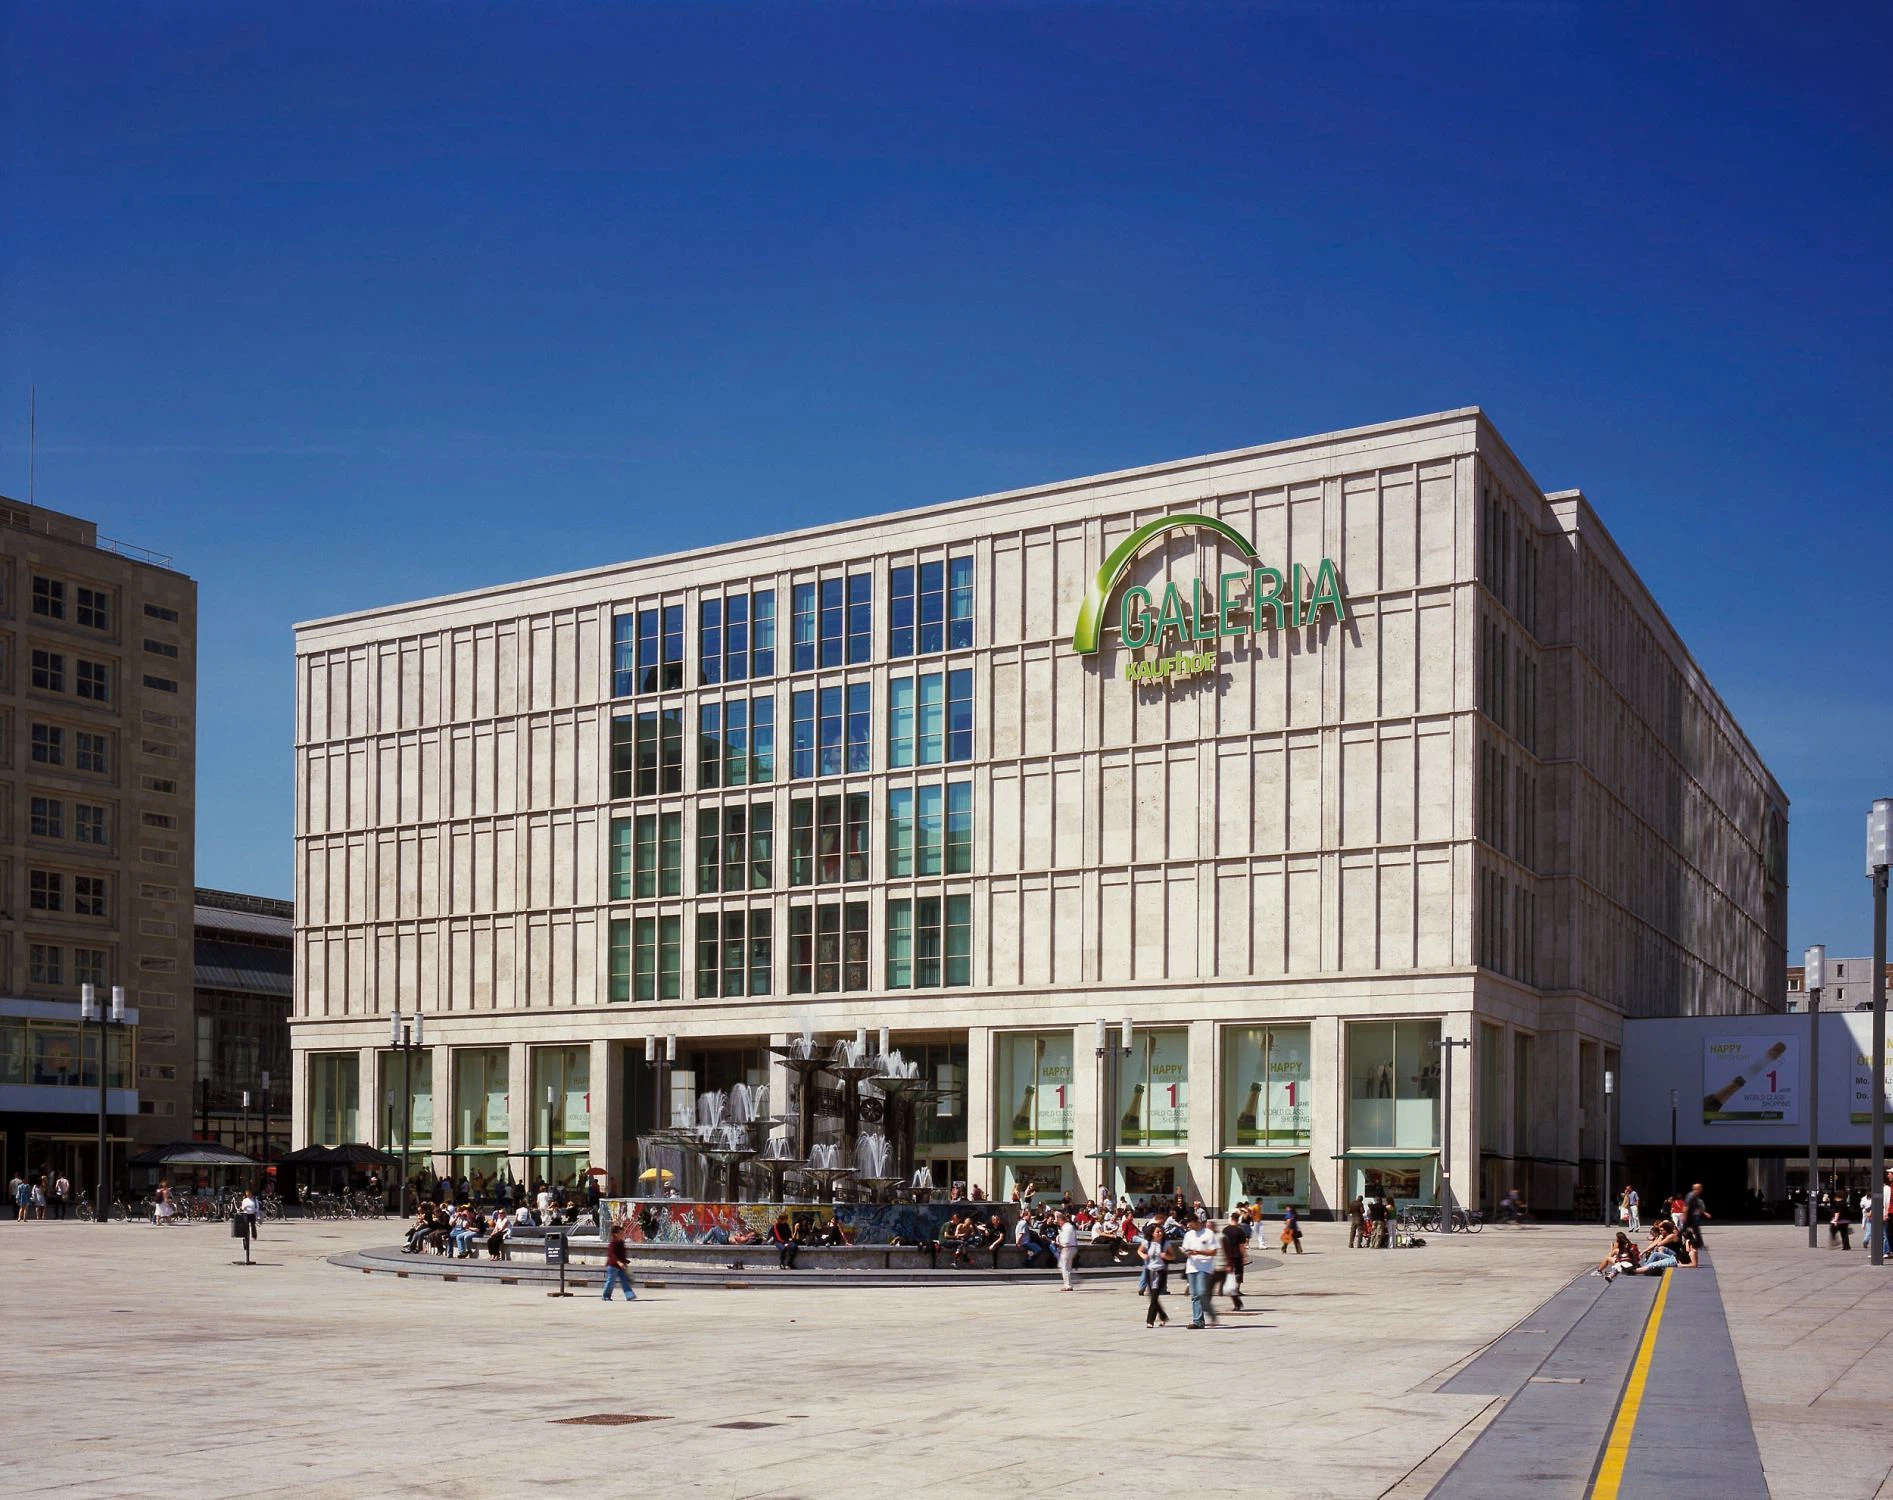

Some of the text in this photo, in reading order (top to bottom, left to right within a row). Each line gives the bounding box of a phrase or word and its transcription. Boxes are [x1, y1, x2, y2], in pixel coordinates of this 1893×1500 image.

[1120, 557, 1346, 650] GALERIA
[1710, 1044, 1742, 1053] HAPPY
[1042, 1067, 1071, 1077] HAPPY
[1152, 1065, 1183, 1075] HAPPY
[1270, 1062, 1302, 1072] HAPPY
[1766, 1070, 1777, 1093] 1
[1055, 1084, 1065, 1109] 1
[1166, 1084, 1176, 1108] 1
[1285, 1082, 1295, 1107] 1
